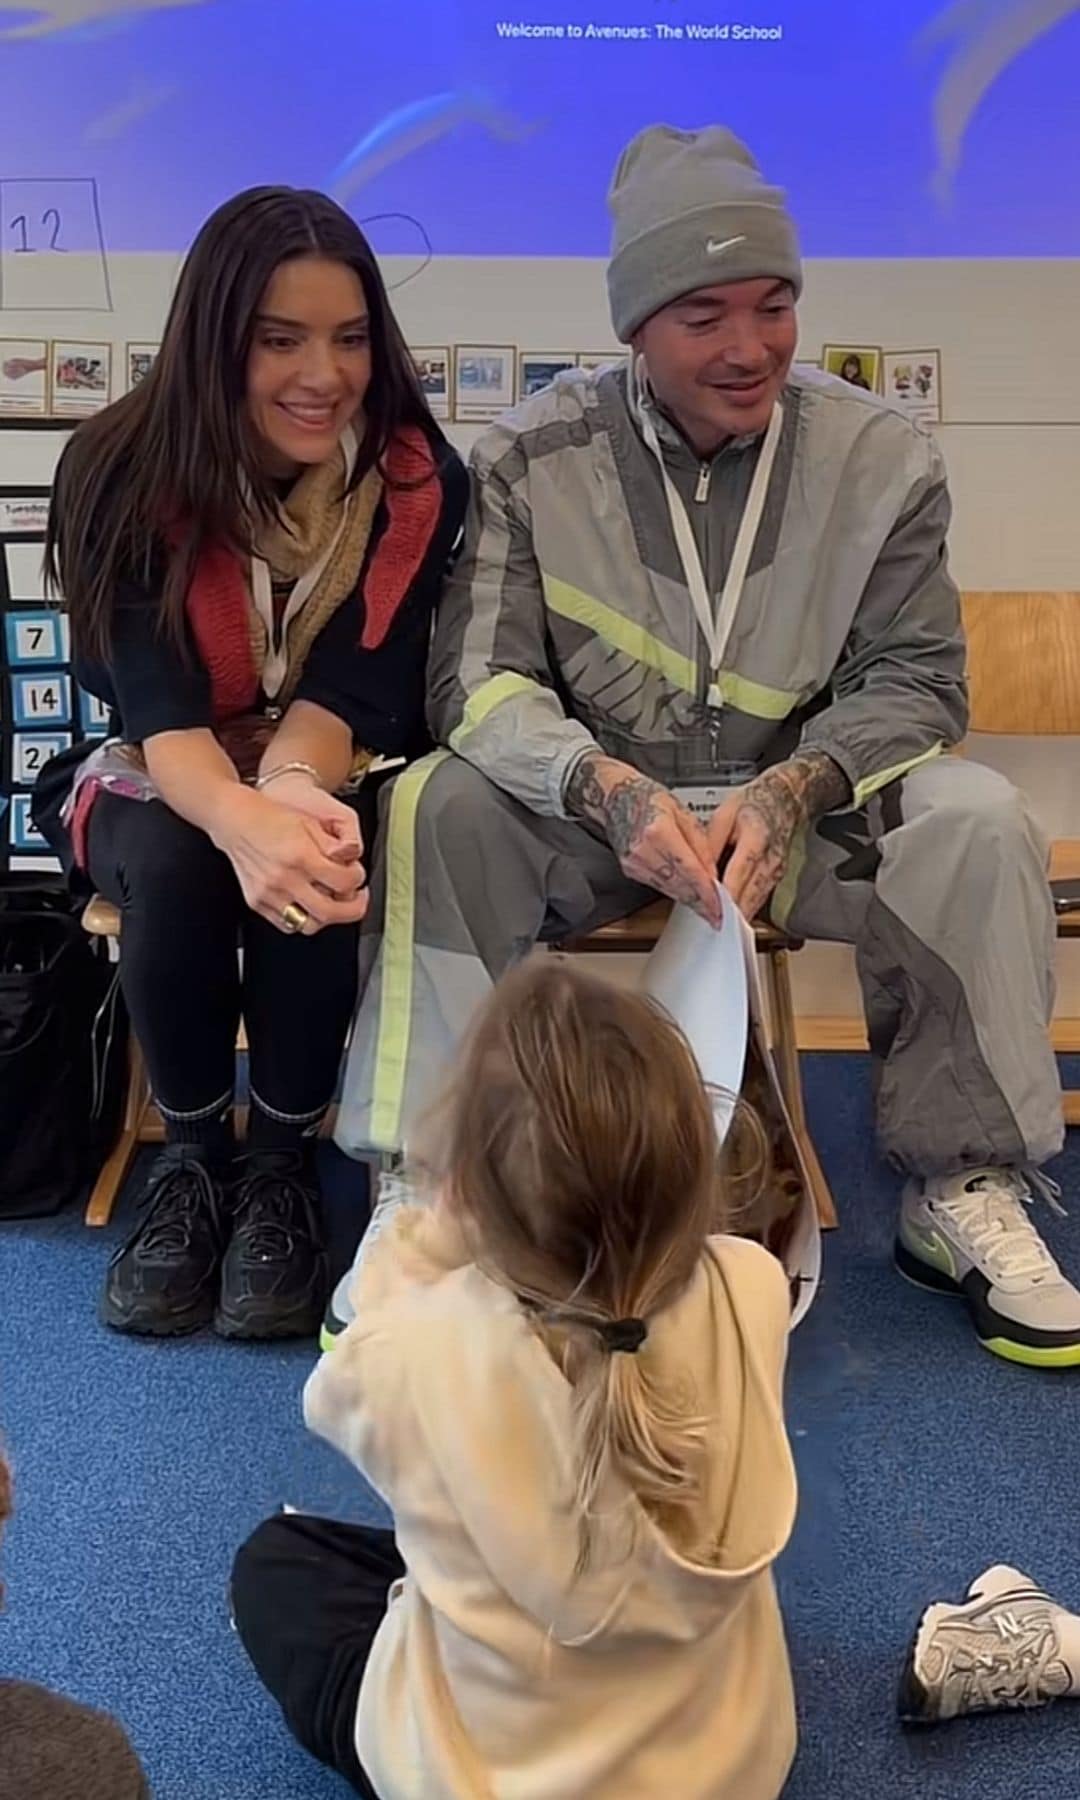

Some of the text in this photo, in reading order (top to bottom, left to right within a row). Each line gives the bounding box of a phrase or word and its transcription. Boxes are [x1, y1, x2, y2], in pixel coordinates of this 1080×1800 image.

[496, 21, 782, 40] Welcome to Avenues: The World School
[10, 208, 68, 253] 12
[26, 627, 44, 650] 7
[31, 687, 58, 712] 14
[993, 1611, 1020, 1638] N
